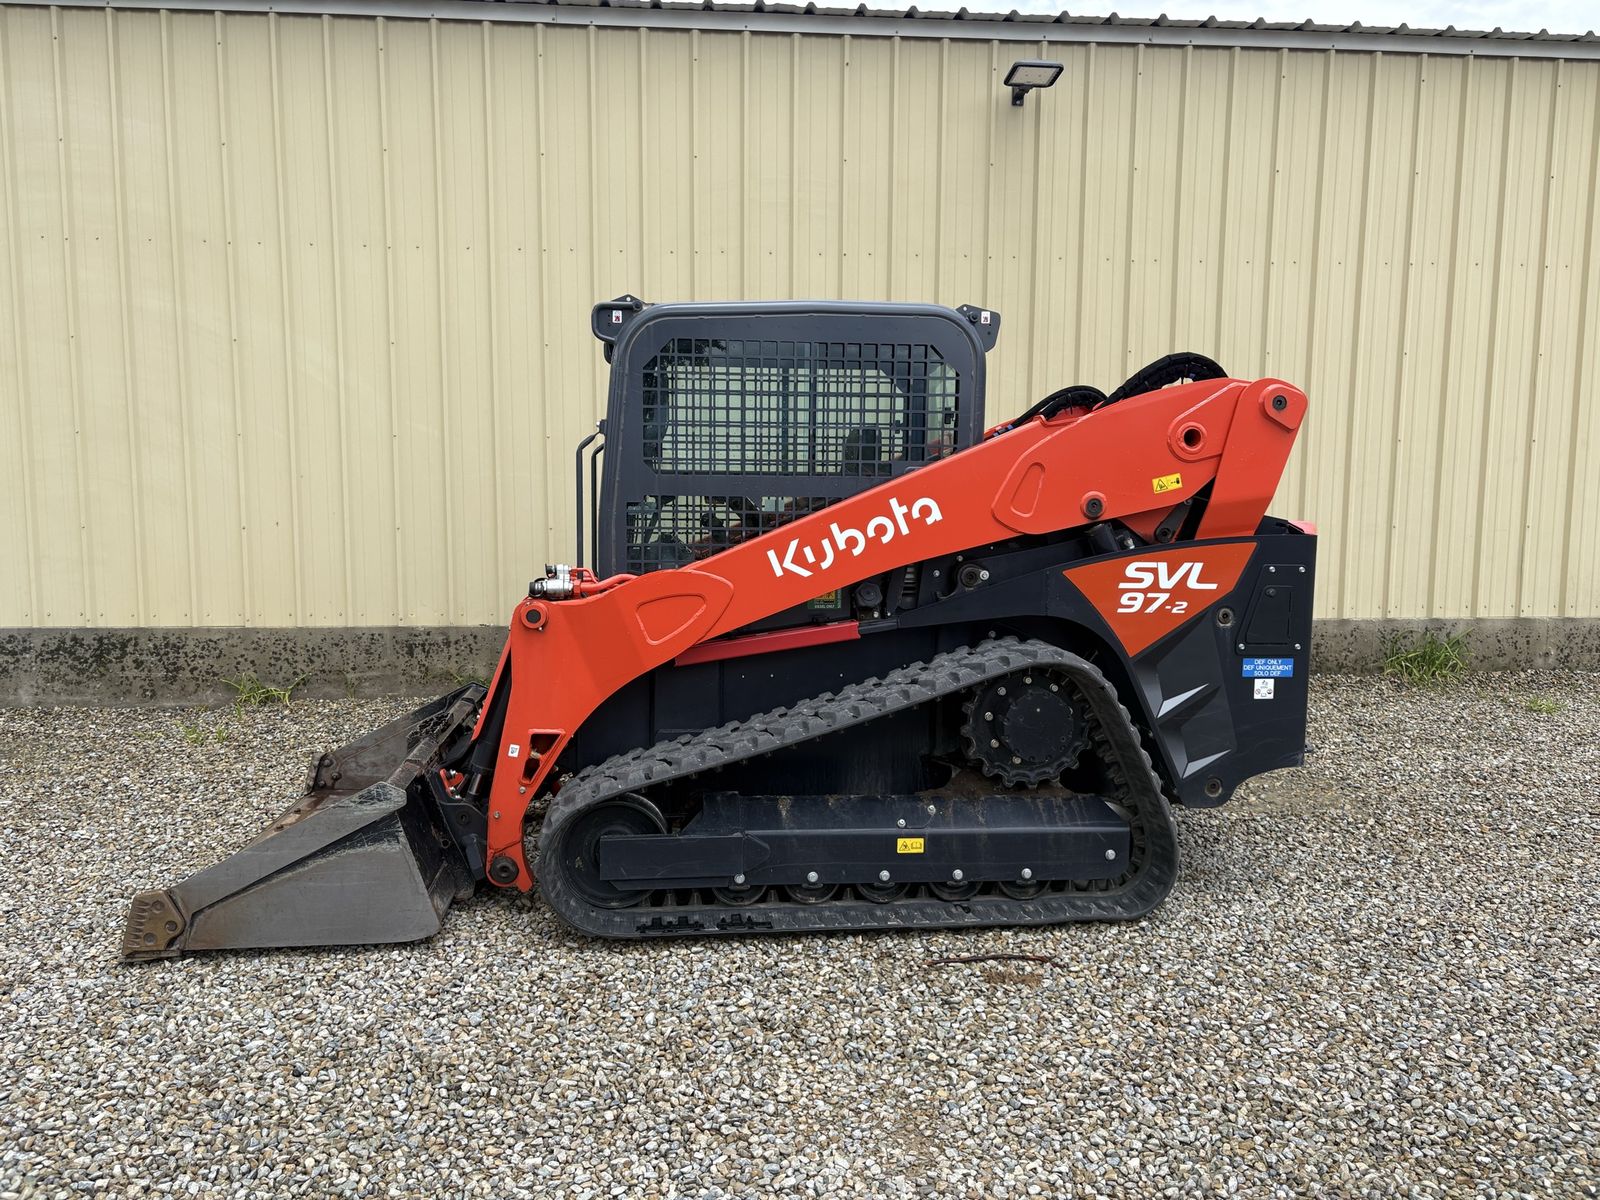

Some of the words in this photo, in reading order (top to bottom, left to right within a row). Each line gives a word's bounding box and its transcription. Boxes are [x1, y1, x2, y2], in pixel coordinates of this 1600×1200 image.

[767, 497, 943, 578] Kubota
[1118, 561, 1218, 589] SVL
[1117, 592, 1188, 613] 97-2
